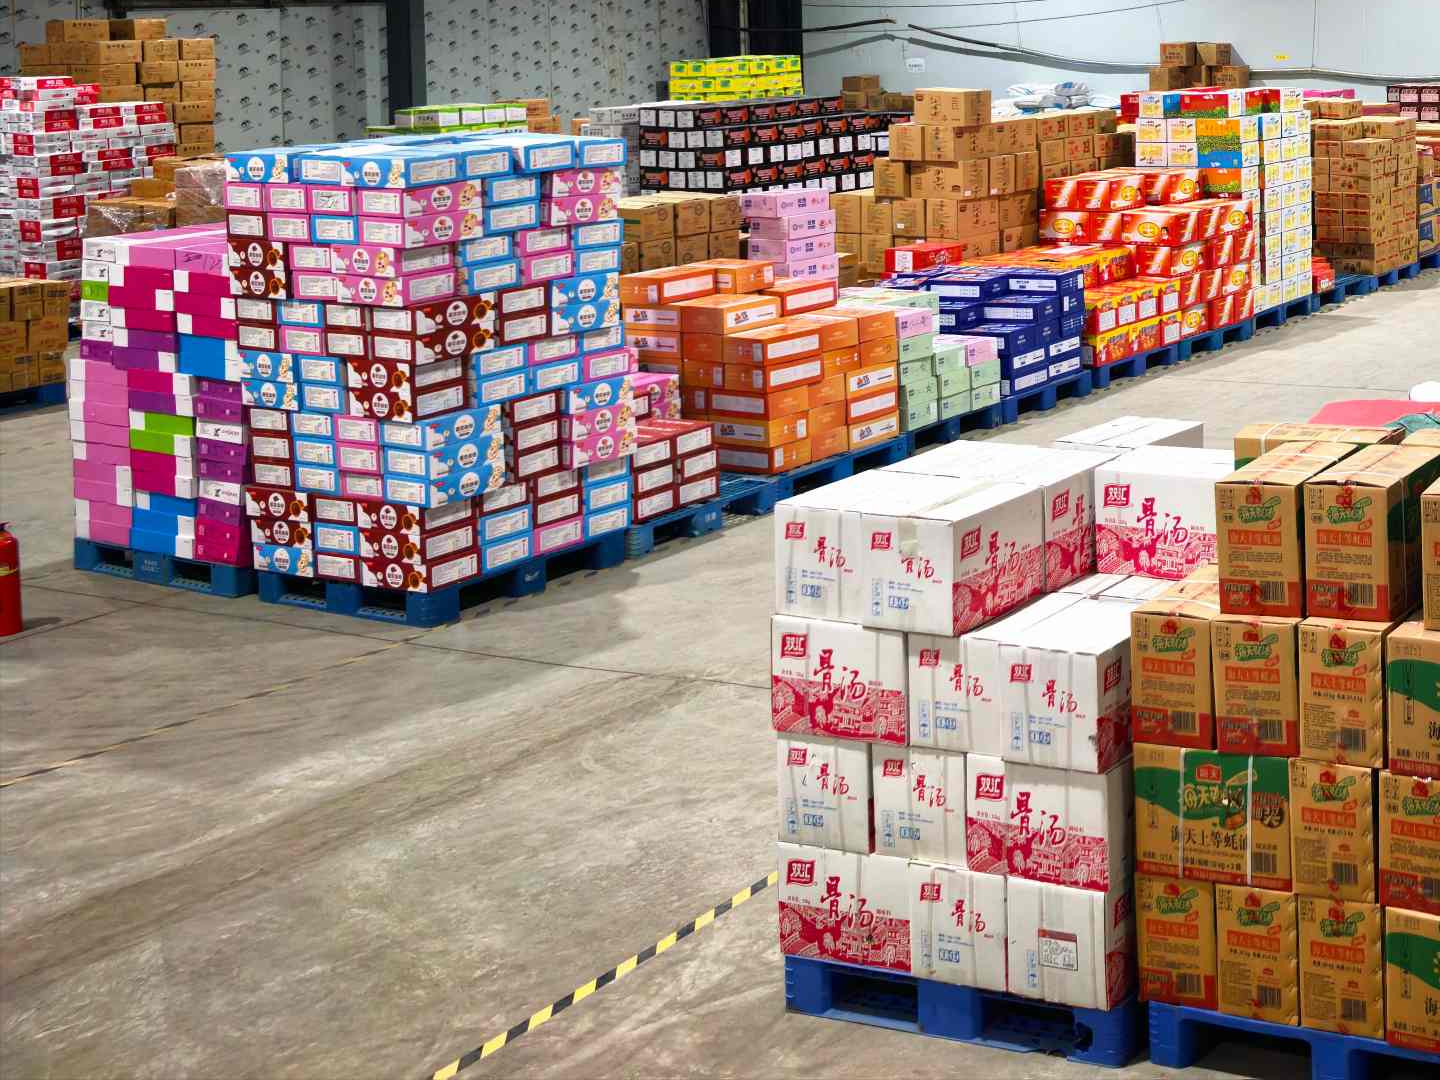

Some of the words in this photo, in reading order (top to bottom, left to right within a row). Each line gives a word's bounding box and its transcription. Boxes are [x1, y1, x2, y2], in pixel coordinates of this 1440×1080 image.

[1104, 484, 1129, 507] 双汇
[1136, 497, 1189, 545] 骨汤
[782, 634, 806, 657] 双汇
[812, 648, 868, 701] 骨汤
[977, 775, 1004, 798] 双汇
[1010, 792, 1067, 845] 骨汤
[819, 875, 875, 929] 骨汤
